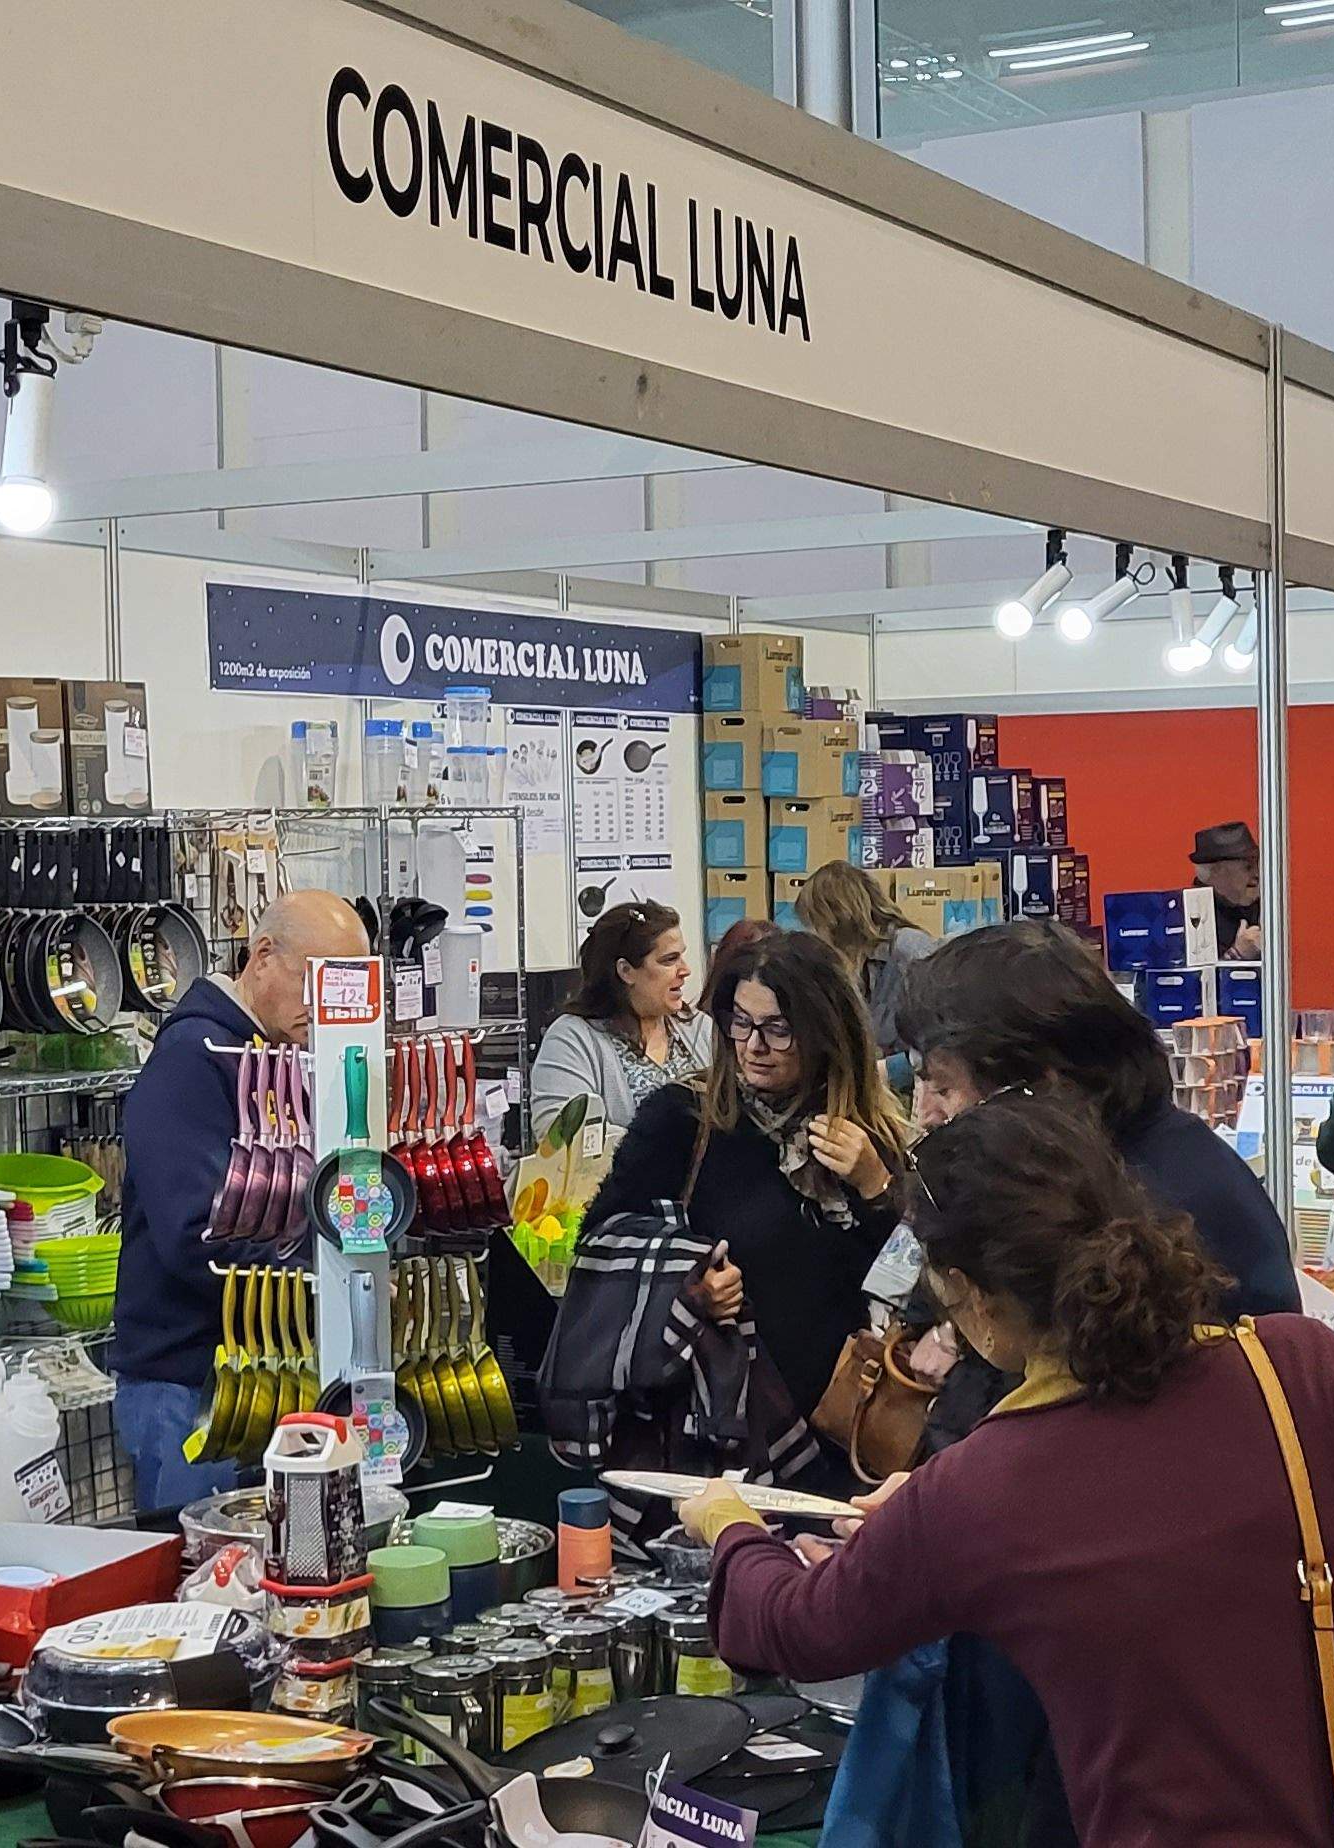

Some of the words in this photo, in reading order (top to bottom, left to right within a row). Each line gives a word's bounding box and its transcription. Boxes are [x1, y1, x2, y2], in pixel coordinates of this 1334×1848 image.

[326, 66, 675, 300] COMERCIAL
[689, 198, 811, 342] LUNA
[218, 661, 255, 676] 1200m2
[256, 662, 267, 678] de
[268, 665, 312, 681] exposición
[425, 633, 579, 680] COMERCIAL
[583, 648, 647, 685] LUNA
[906, 887, 951, 897] Luminarc
[701, 1811, 746, 1842] LUNA
